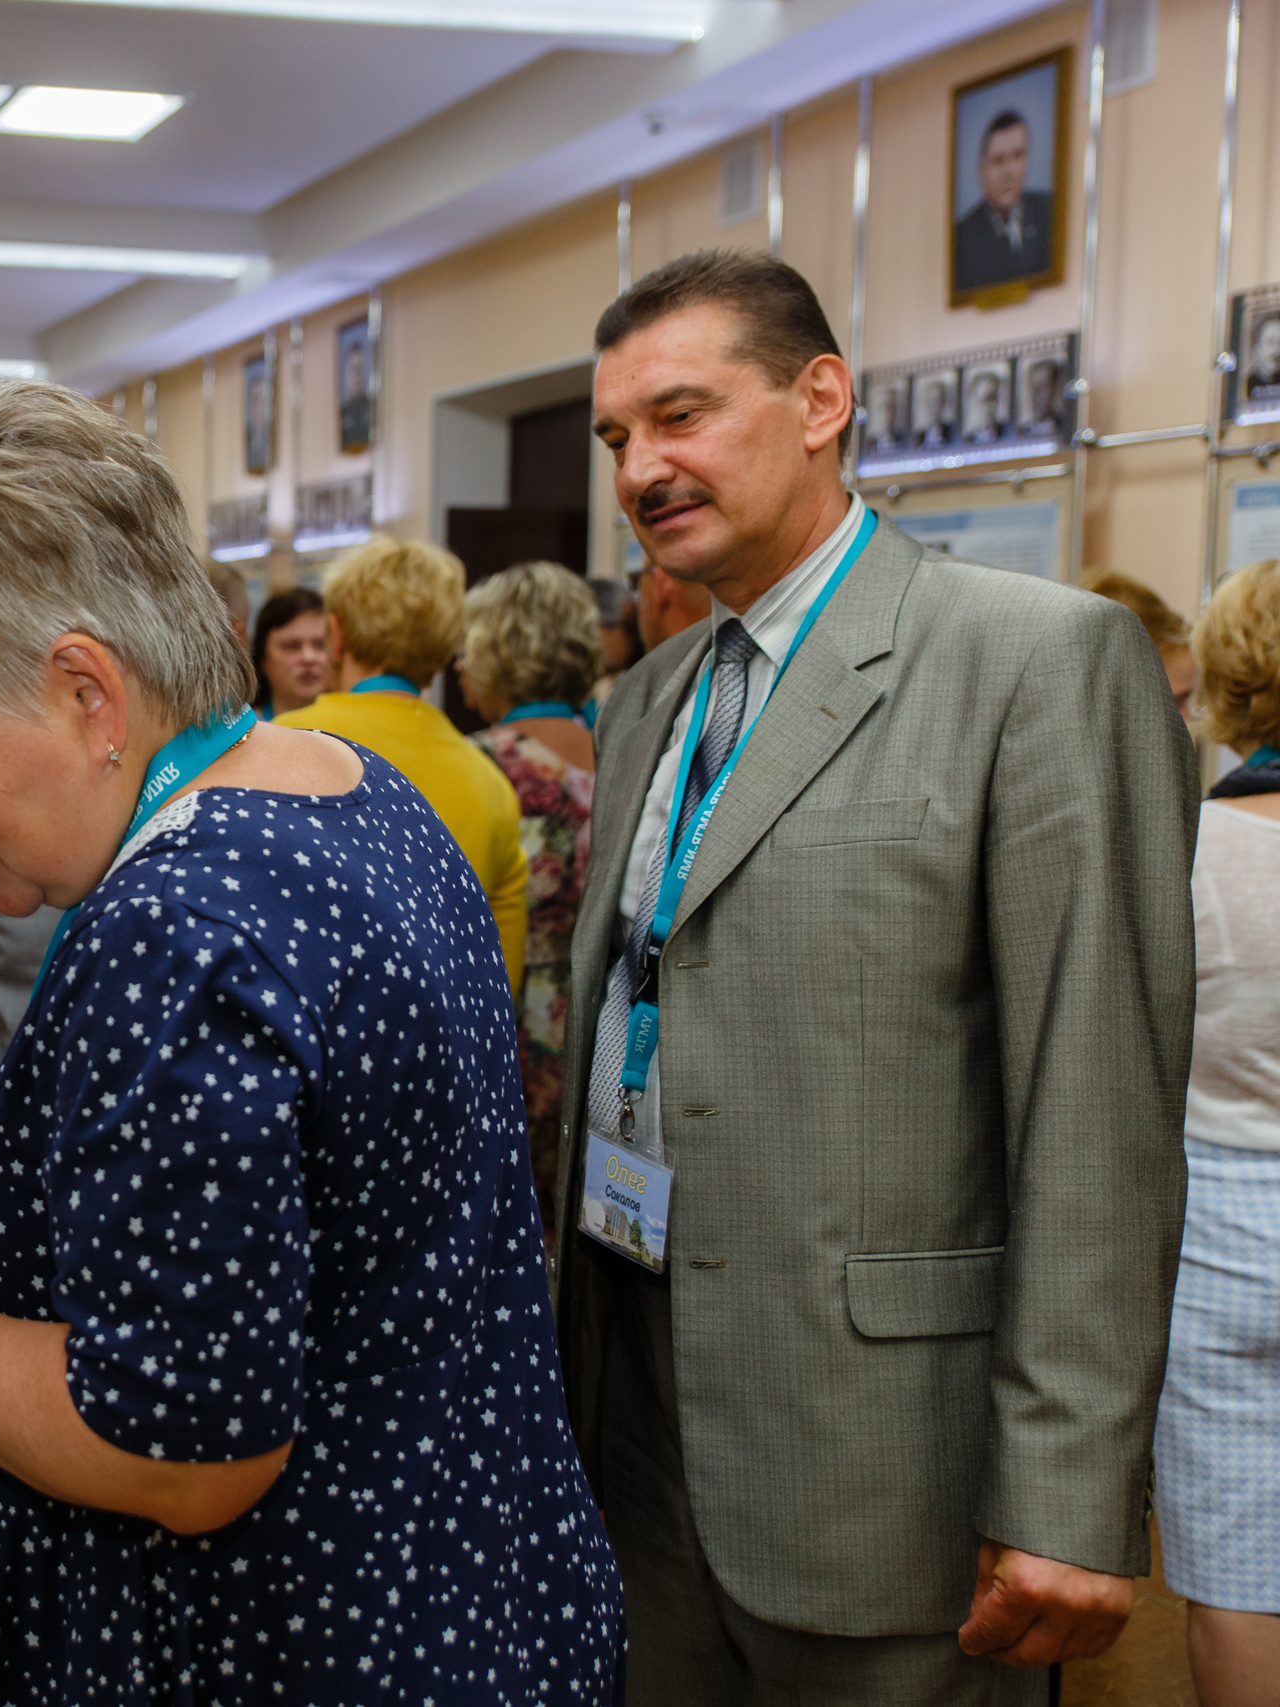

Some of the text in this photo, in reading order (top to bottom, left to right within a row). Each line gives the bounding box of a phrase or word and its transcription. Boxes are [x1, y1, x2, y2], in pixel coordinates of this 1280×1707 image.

[634, 1013, 653, 1053] ЯГМУ
[606, 1154, 647, 1194] Олег
[605, 1184, 641, 1213] Соколов
